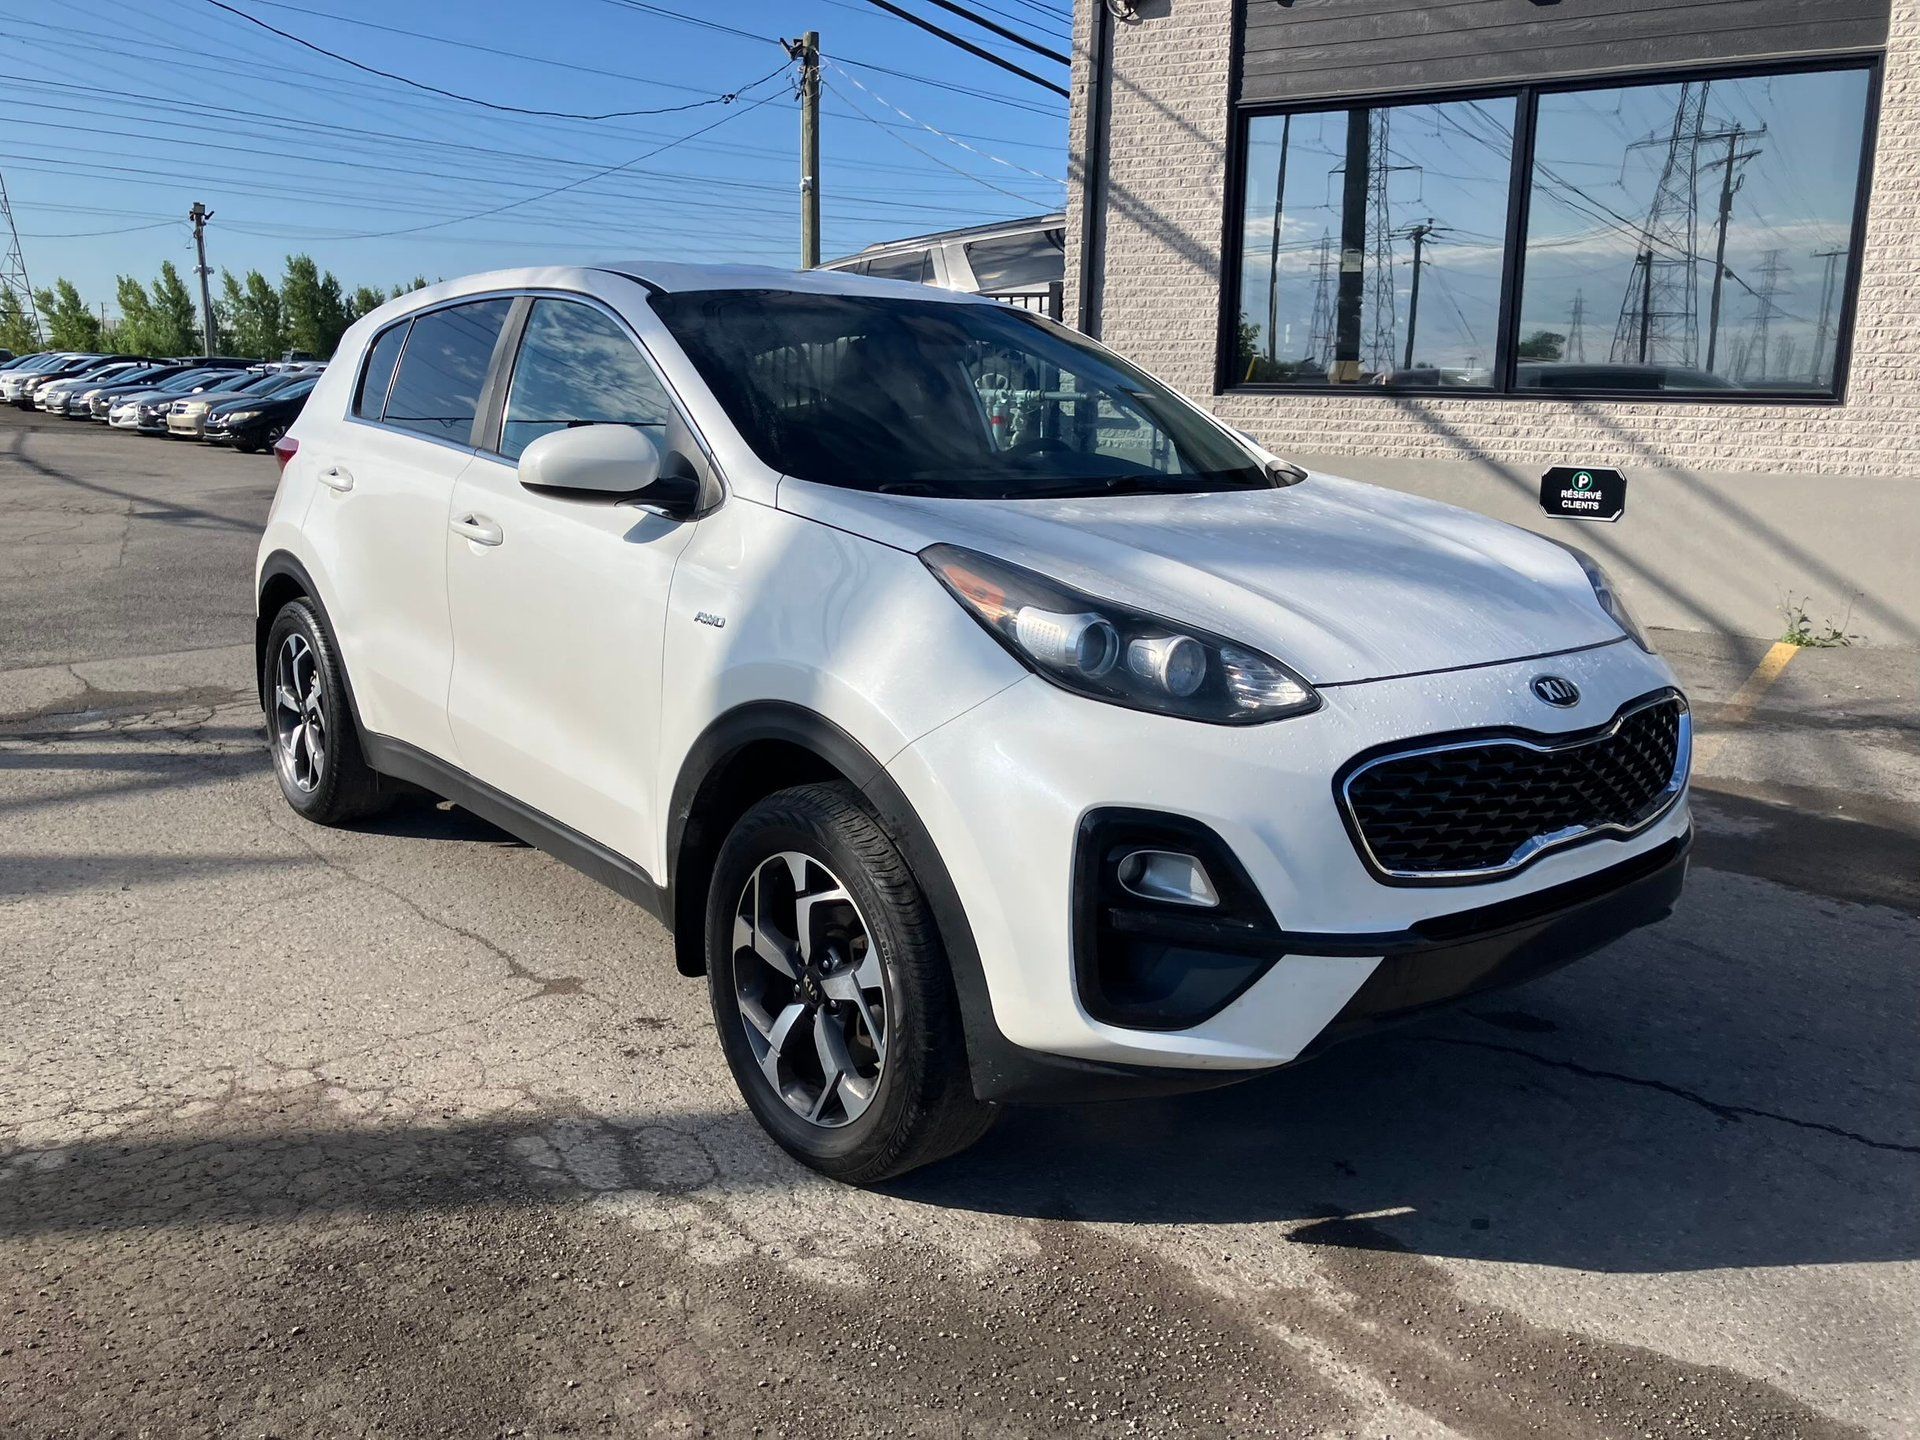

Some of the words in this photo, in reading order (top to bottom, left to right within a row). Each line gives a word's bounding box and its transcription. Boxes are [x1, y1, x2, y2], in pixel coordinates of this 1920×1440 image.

[1560, 489, 1602, 500] RÉSERVÉ
[1561, 500, 1599, 510] CLIENTS
[694, 611, 726, 628] AWD
[1537, 679, 1578, 701] KIA
